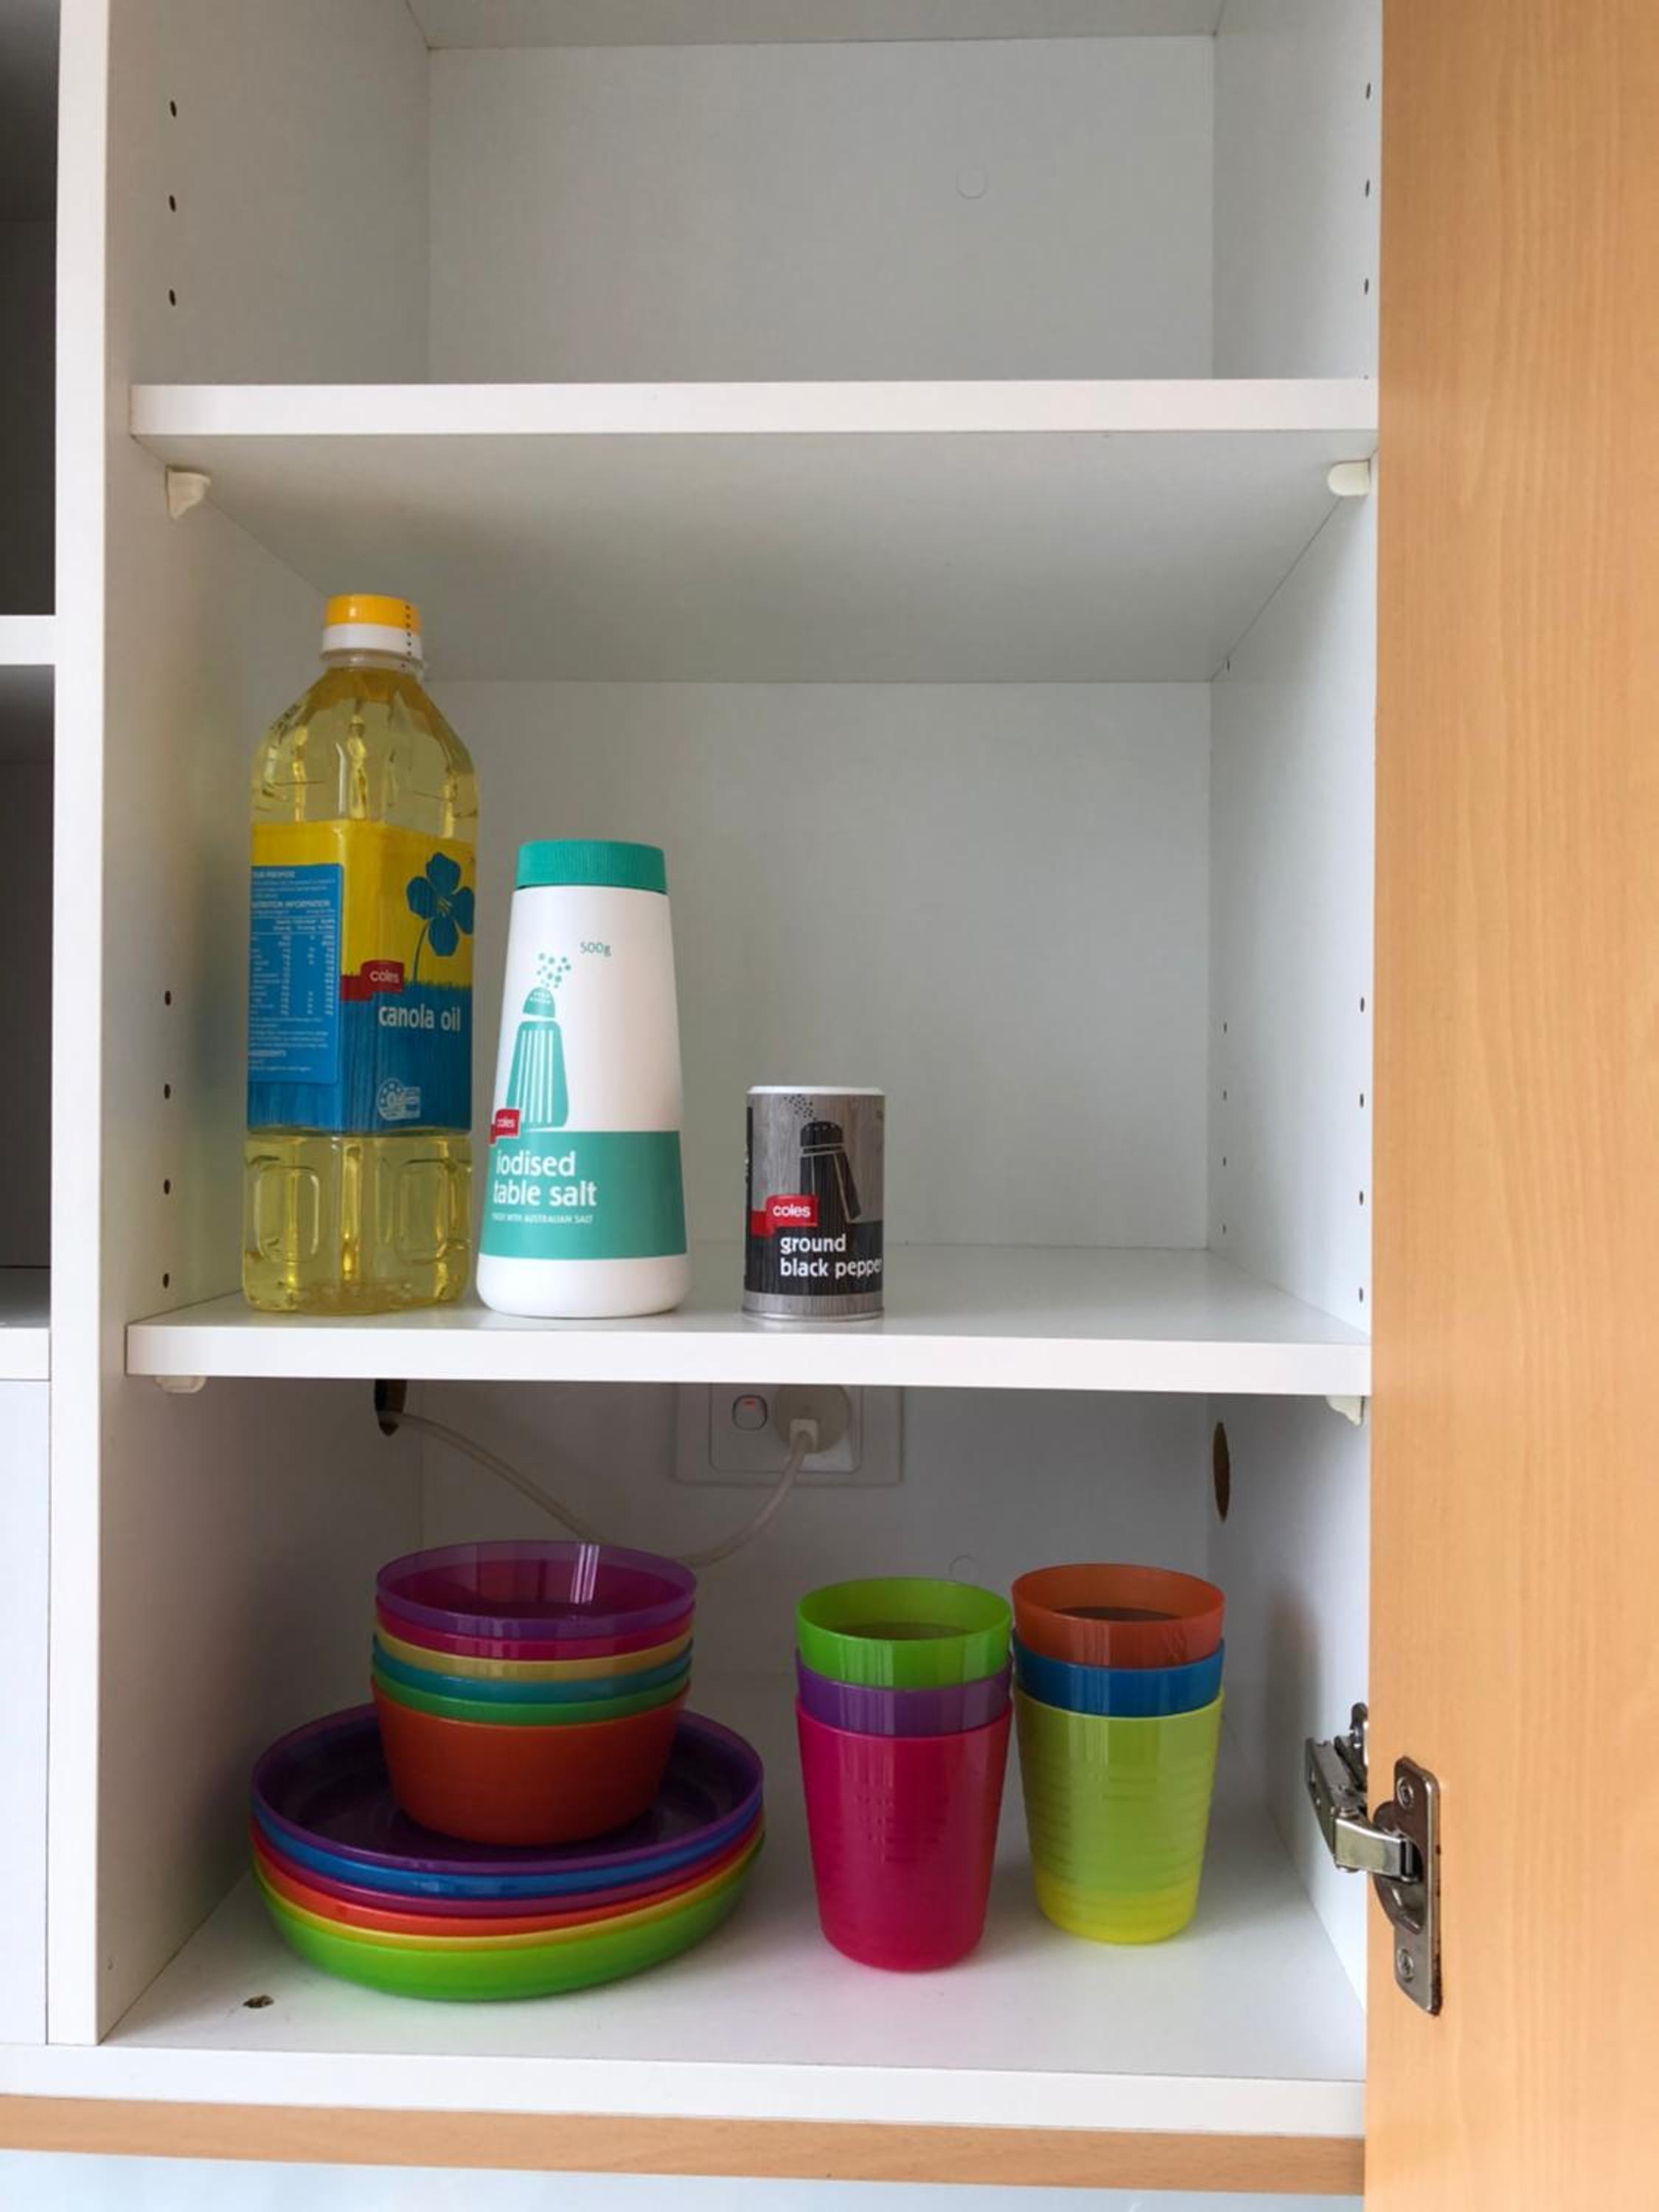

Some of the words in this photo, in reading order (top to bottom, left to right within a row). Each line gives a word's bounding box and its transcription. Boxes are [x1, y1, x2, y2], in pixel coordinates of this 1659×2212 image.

[579, 942, 612, 957] 500g
[369, 970, 399, 983] coles
[378, 1004, 434, 1029] canola
[441, 1007, 461, 1031] oil
[496, 1150, 576, 1176] iodised
[493, 1179, 541, 1206] table
[549, 1180, 597, 1206] salt
[773, 1203, 811, 1217] coles
[780, 1233, 846, 1255] ground
[780, 1257, 828, 1277] black
